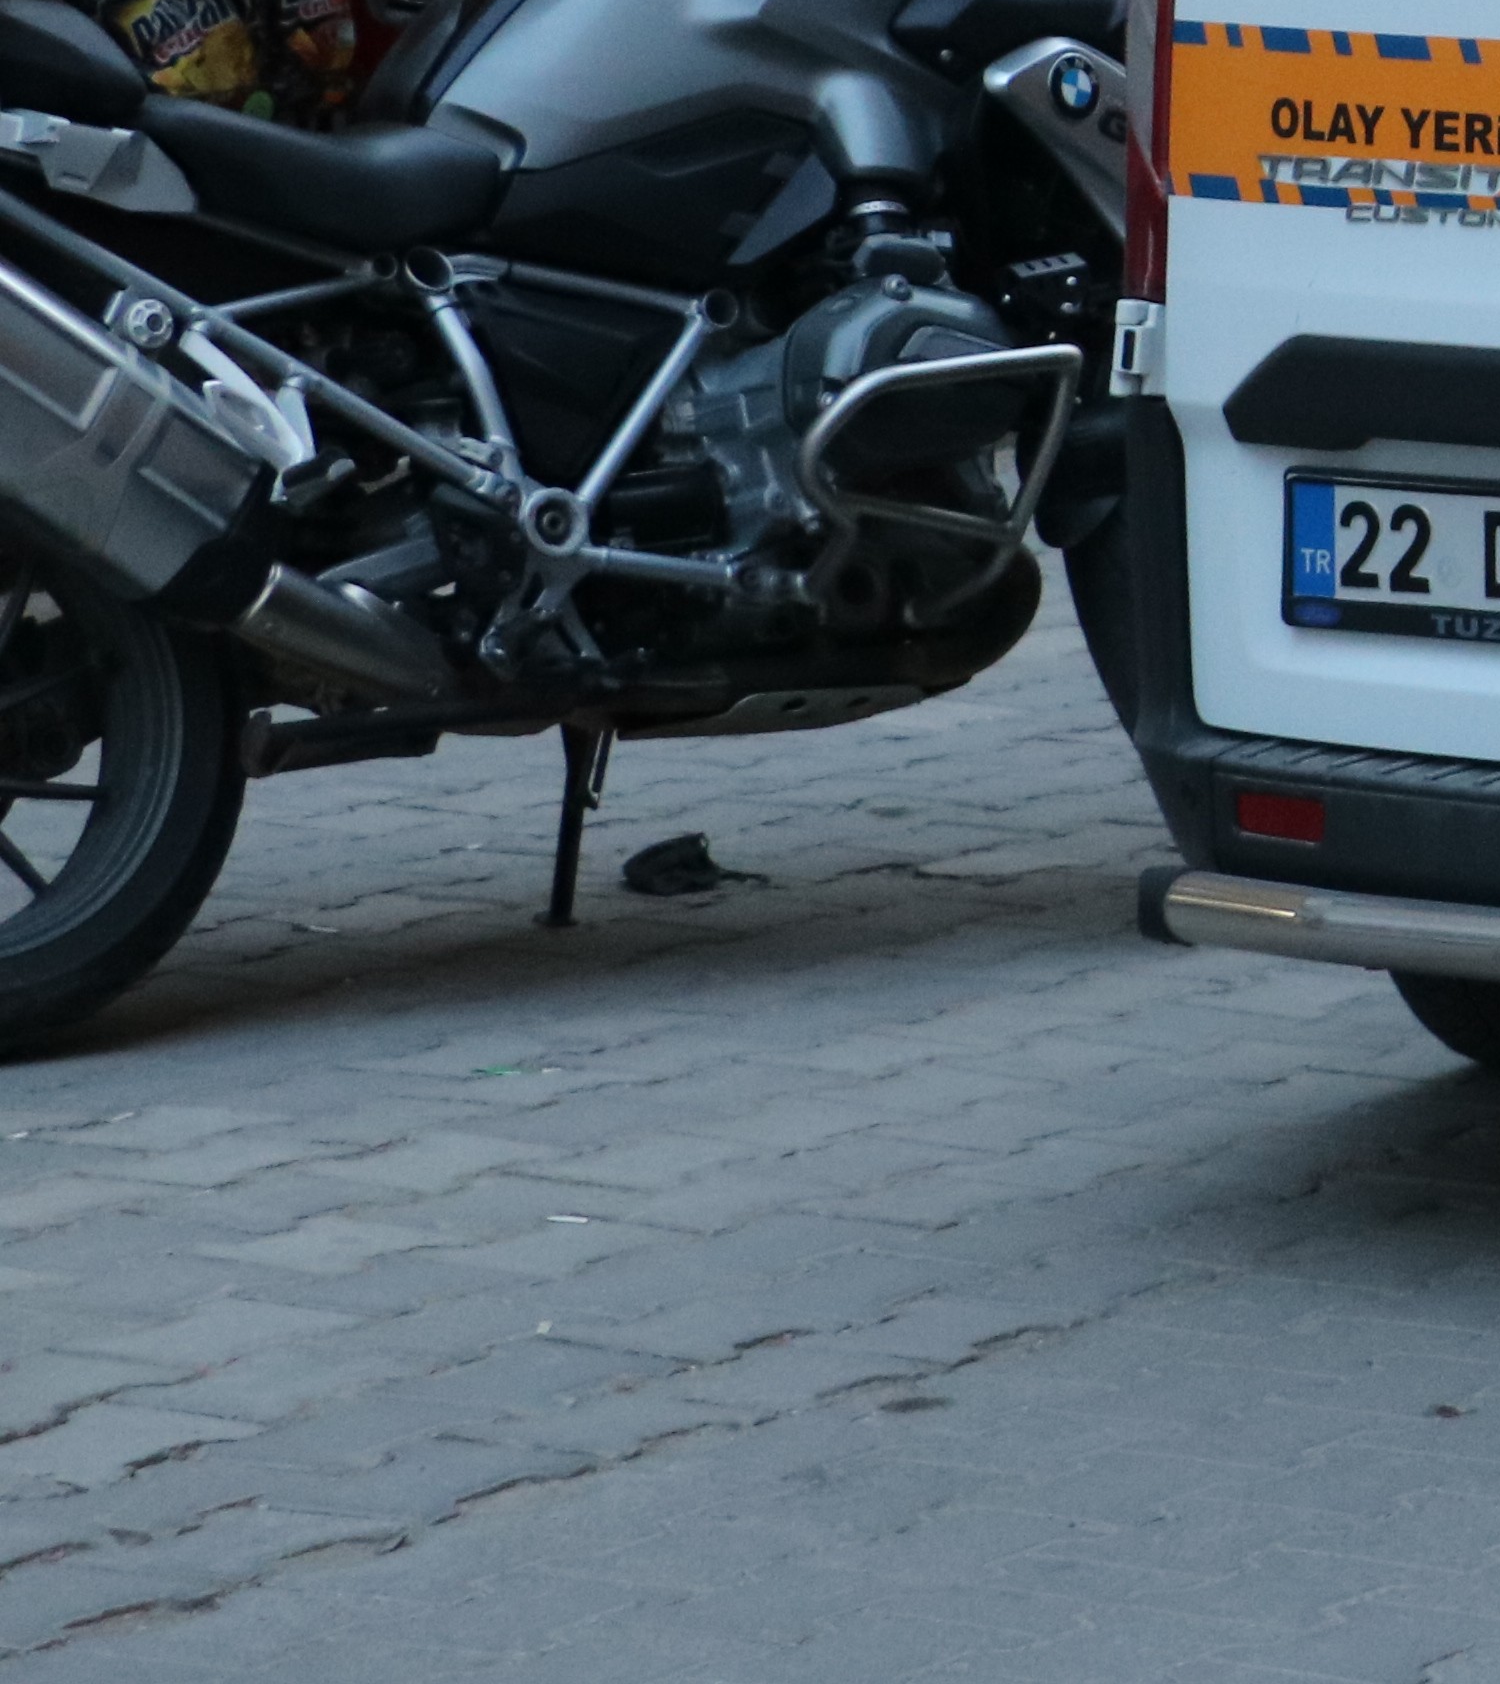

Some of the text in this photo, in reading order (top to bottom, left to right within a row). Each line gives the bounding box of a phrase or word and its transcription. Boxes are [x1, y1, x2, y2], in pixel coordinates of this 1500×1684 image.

[1269, 97, 1386, 149] OLAY
[1300, 548, 1331, 576] TR
[1338, 500, 1432, 595] 22
